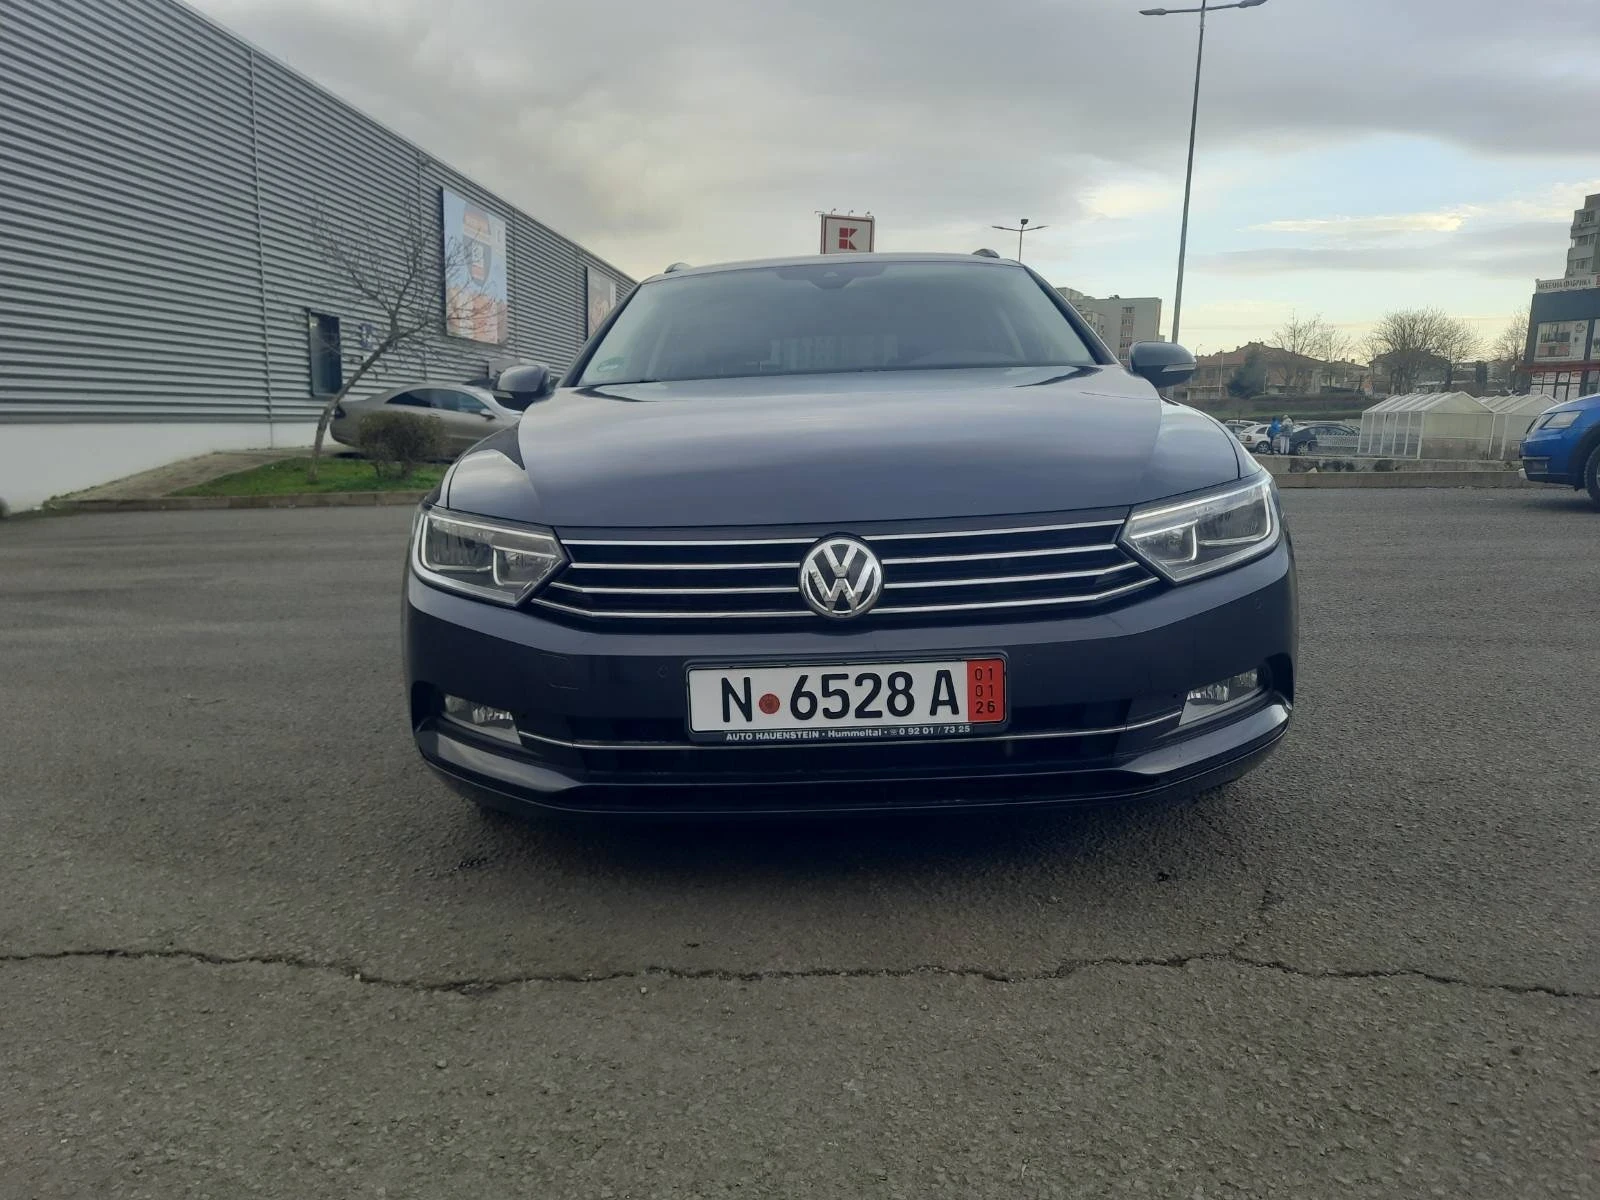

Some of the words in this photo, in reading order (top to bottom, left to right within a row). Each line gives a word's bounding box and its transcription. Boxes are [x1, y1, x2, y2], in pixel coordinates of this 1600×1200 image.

[838, 227, 858, 250] K
[974, 667, 994, 681] 01
[721, 676, 753, 723] N
[789, 670, 917, 721] 6528
[929, 669, 960, 717] A
[975, 684, 994, 698] 01
[975, 700, 996, 714] 26
[726, 733, 753, 741] AUTO
[756, 730, 819, 740] HAUENSTEIN
